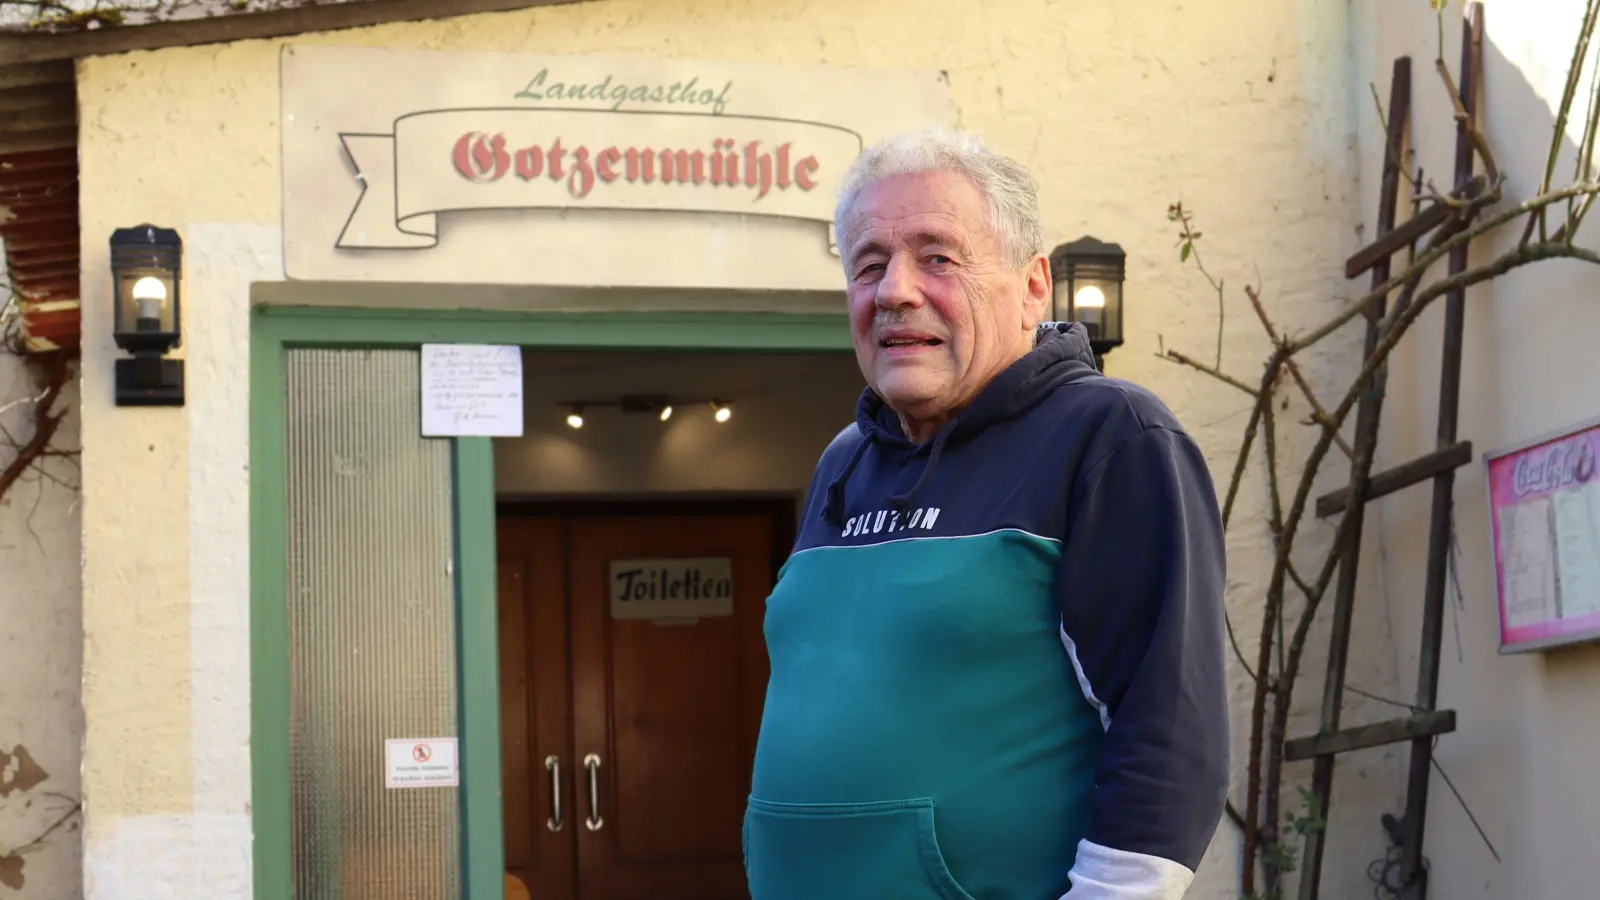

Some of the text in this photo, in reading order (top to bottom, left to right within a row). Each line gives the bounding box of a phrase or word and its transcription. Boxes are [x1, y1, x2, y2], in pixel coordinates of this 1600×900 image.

[514, 69, 732, 113] Landgasthof
[452, 129, 820, 201] Gotzenmühle
[616, 568, 732, 602] Toiletten
